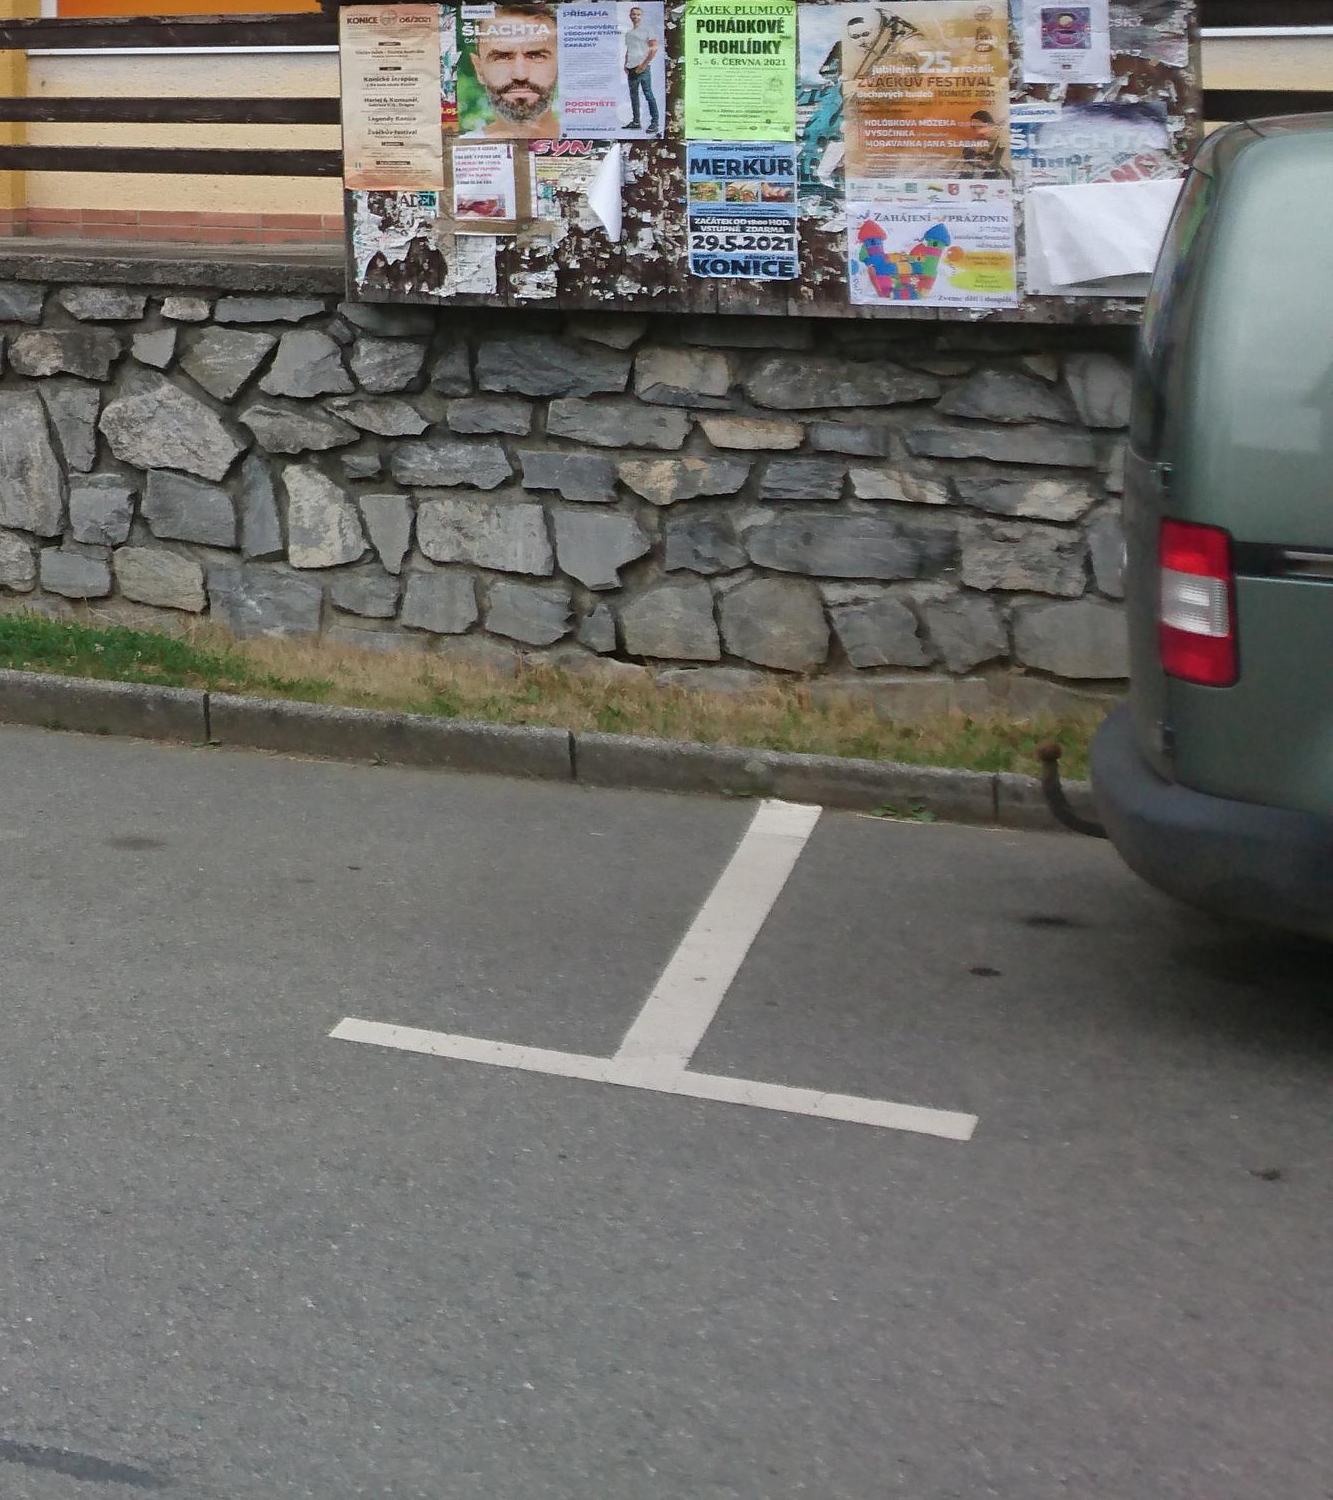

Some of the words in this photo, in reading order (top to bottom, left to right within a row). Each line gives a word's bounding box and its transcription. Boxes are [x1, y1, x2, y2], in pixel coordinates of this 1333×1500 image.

[563, 8, 609, 18] PŘÍSAHA
[689, 3, 730, 15] ZÁMEK
[734, 5, 793, 15] PLUMLOV
[347, 16, 379, 24] KONICE
[696, 17, 785, 34] POHÁDKOVÉ
[462, 22, 551, 36] ŠLACHTA
[699, 38, 782, 54] PROHLÍDKY
[722, 57, 761, 66] ČERVNA
[763, 58, 787, 66] 2021
[927, 76, 995, 87] FESTIVAL
[865, 129, 915, 137] VYSOČINKA
[689, 158, 795, 175] MERKUR
[694, 217, 732, 225] ZAČÁTEK
[693, 235, 794, 252] 29.5.2021
[693, 259, 794, 277] KONICE
